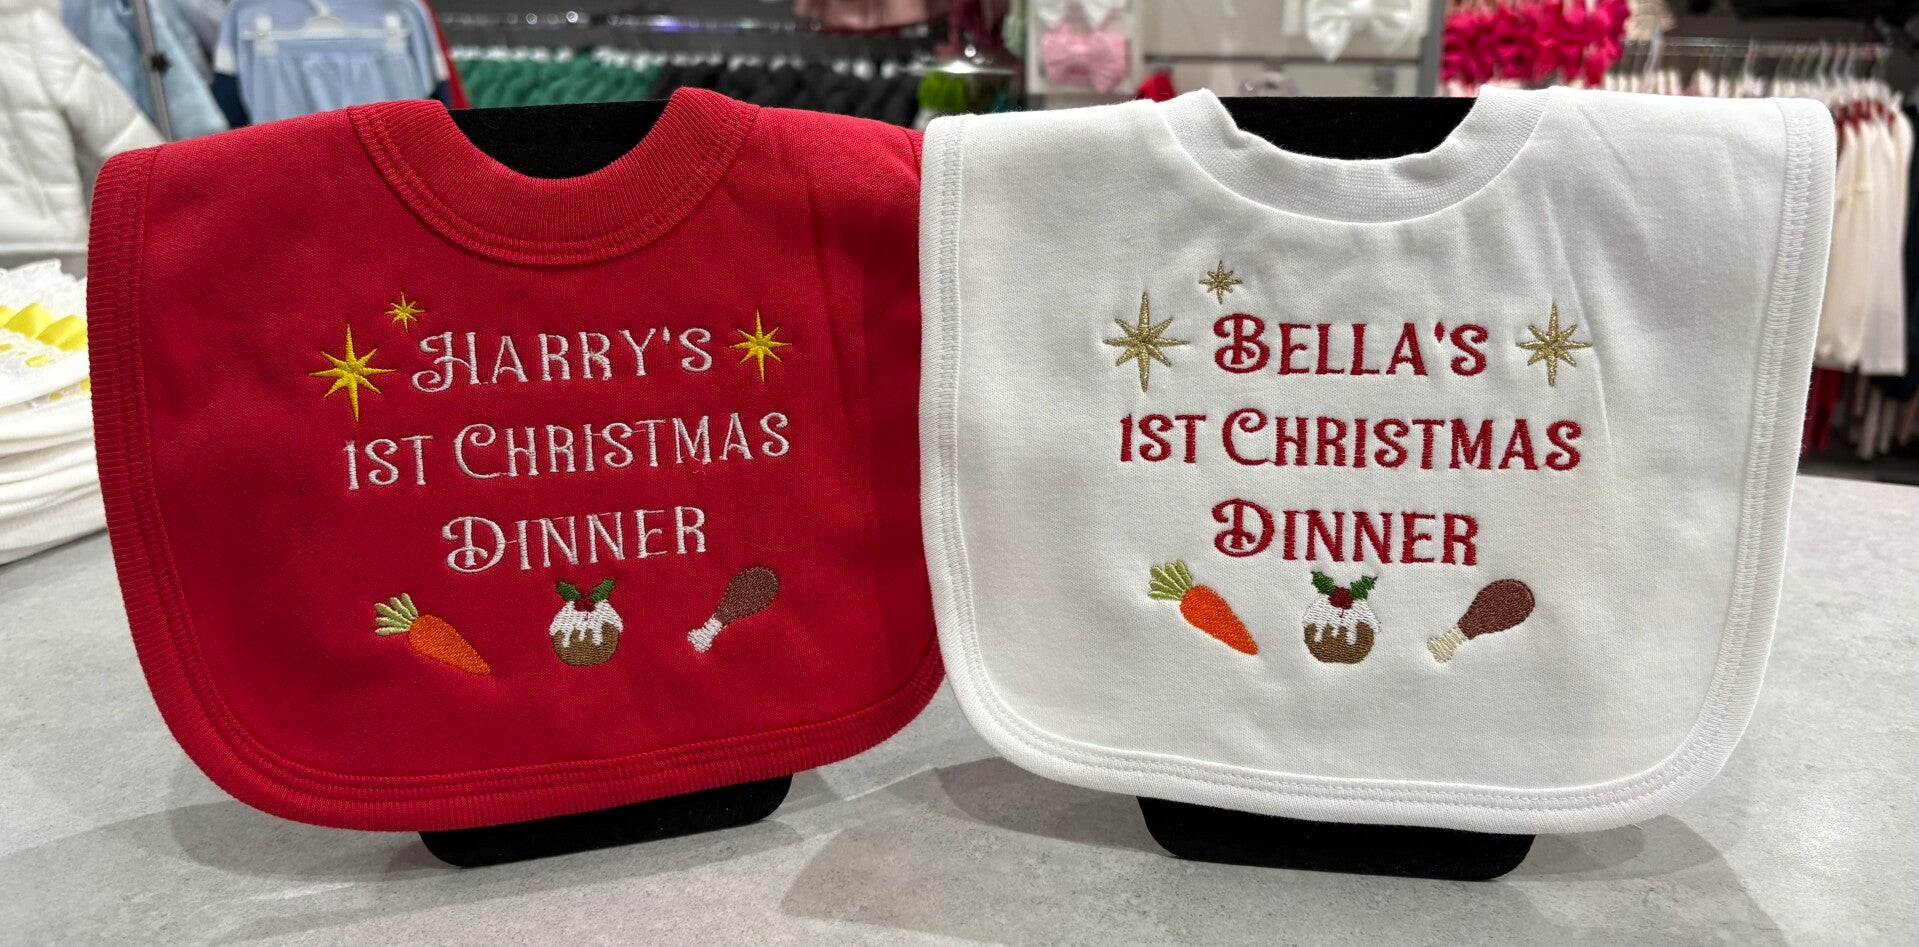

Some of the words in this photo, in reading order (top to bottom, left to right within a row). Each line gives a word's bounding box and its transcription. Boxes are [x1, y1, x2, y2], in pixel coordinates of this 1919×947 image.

[411, 326, 713, 393] HARRY'S
[1213, 313, 1488, 377] BELLA'S
[343, 435, 433, 490] 1ST
[452, 411, 790, 480] CHRISTMAS
[1119, 413, 1207, 464] 1ST
[1221, 407, 1582, 471] CHRISTMAS
[441, 505, 707, 573] DINNER
[1211, 498, 1479, 567] DINNER
